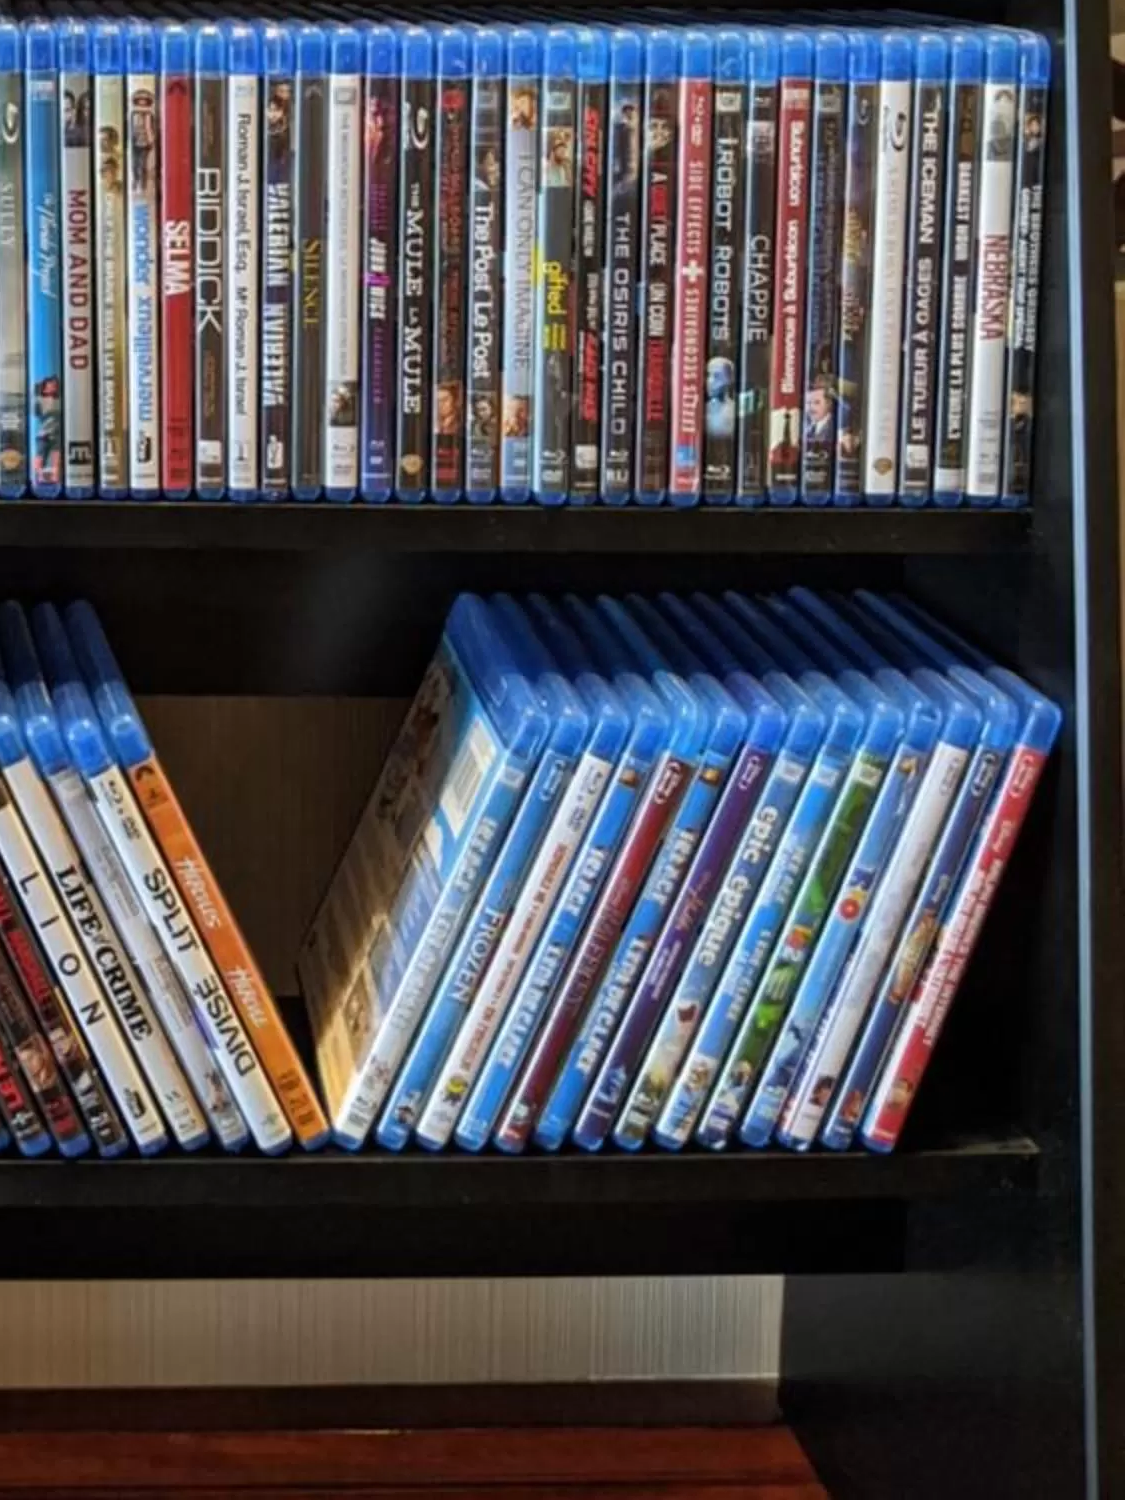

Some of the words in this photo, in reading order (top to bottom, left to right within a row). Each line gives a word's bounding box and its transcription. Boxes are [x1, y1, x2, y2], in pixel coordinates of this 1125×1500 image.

[922, 110, 938, 152] THE
[409, 183, 422, 208] THE
[518, 166, 535, 211] CAN
[650, 171, 668, 182] A
[688, 161, 703, 196] SIDE
[918, 156, 937, 245] ICEMAN
[955, 161, 973, 221] DARKEST
[0, 182, 19, 250] SULLY
[69, 190, 89, 246] MOM
[266, 182, 292, 287] VALERIAN
[475, 203, 496, 243] The
[614, 213, 632, 259] THE
[686, 196, 702, 254] EFFECTS
[954, 223, 971, 261] HOUR
[133, 204, 154, 285] wonder
[164, 220, 191, 297] SELMA
[196, 167, 223, 334] RIDDICK
[404, 209, 428, 297] MULE
[473, 245, 495, 294] Post
[516, 217, 535, 273] ONLY
[648, 223, 667, 267] PLACE
[69, 253, 89, 308] AND
[302, 238, 325, 329] SILENCE
[542, 261, 568, 316] gifted
[648, 282, 666, 301] UN
[980, 232, 1009, 342] NEBRASKA
[408, 307, 420, 325] LA
[473, 302, 491, 329] Le
[513, 279, 533, 372] IMAGINE
[611, 268, 631, 351] OSIRIS
[647, 304, 666, 337] COIN
[69, 316, 90, 372] DAD
[402, 325, 425, 415] MULE
[471, 333, 491, 380] Post
[610, 360, 629, 436] CHILD
[743, 804, 780, 865] epic
[143, 868, 196, 956] SPLIT
[57, 865, 100, 936] LIFE
[95, 944, 151, 1041] CRIME
[451, 907, 502, 1003] FROZEN
